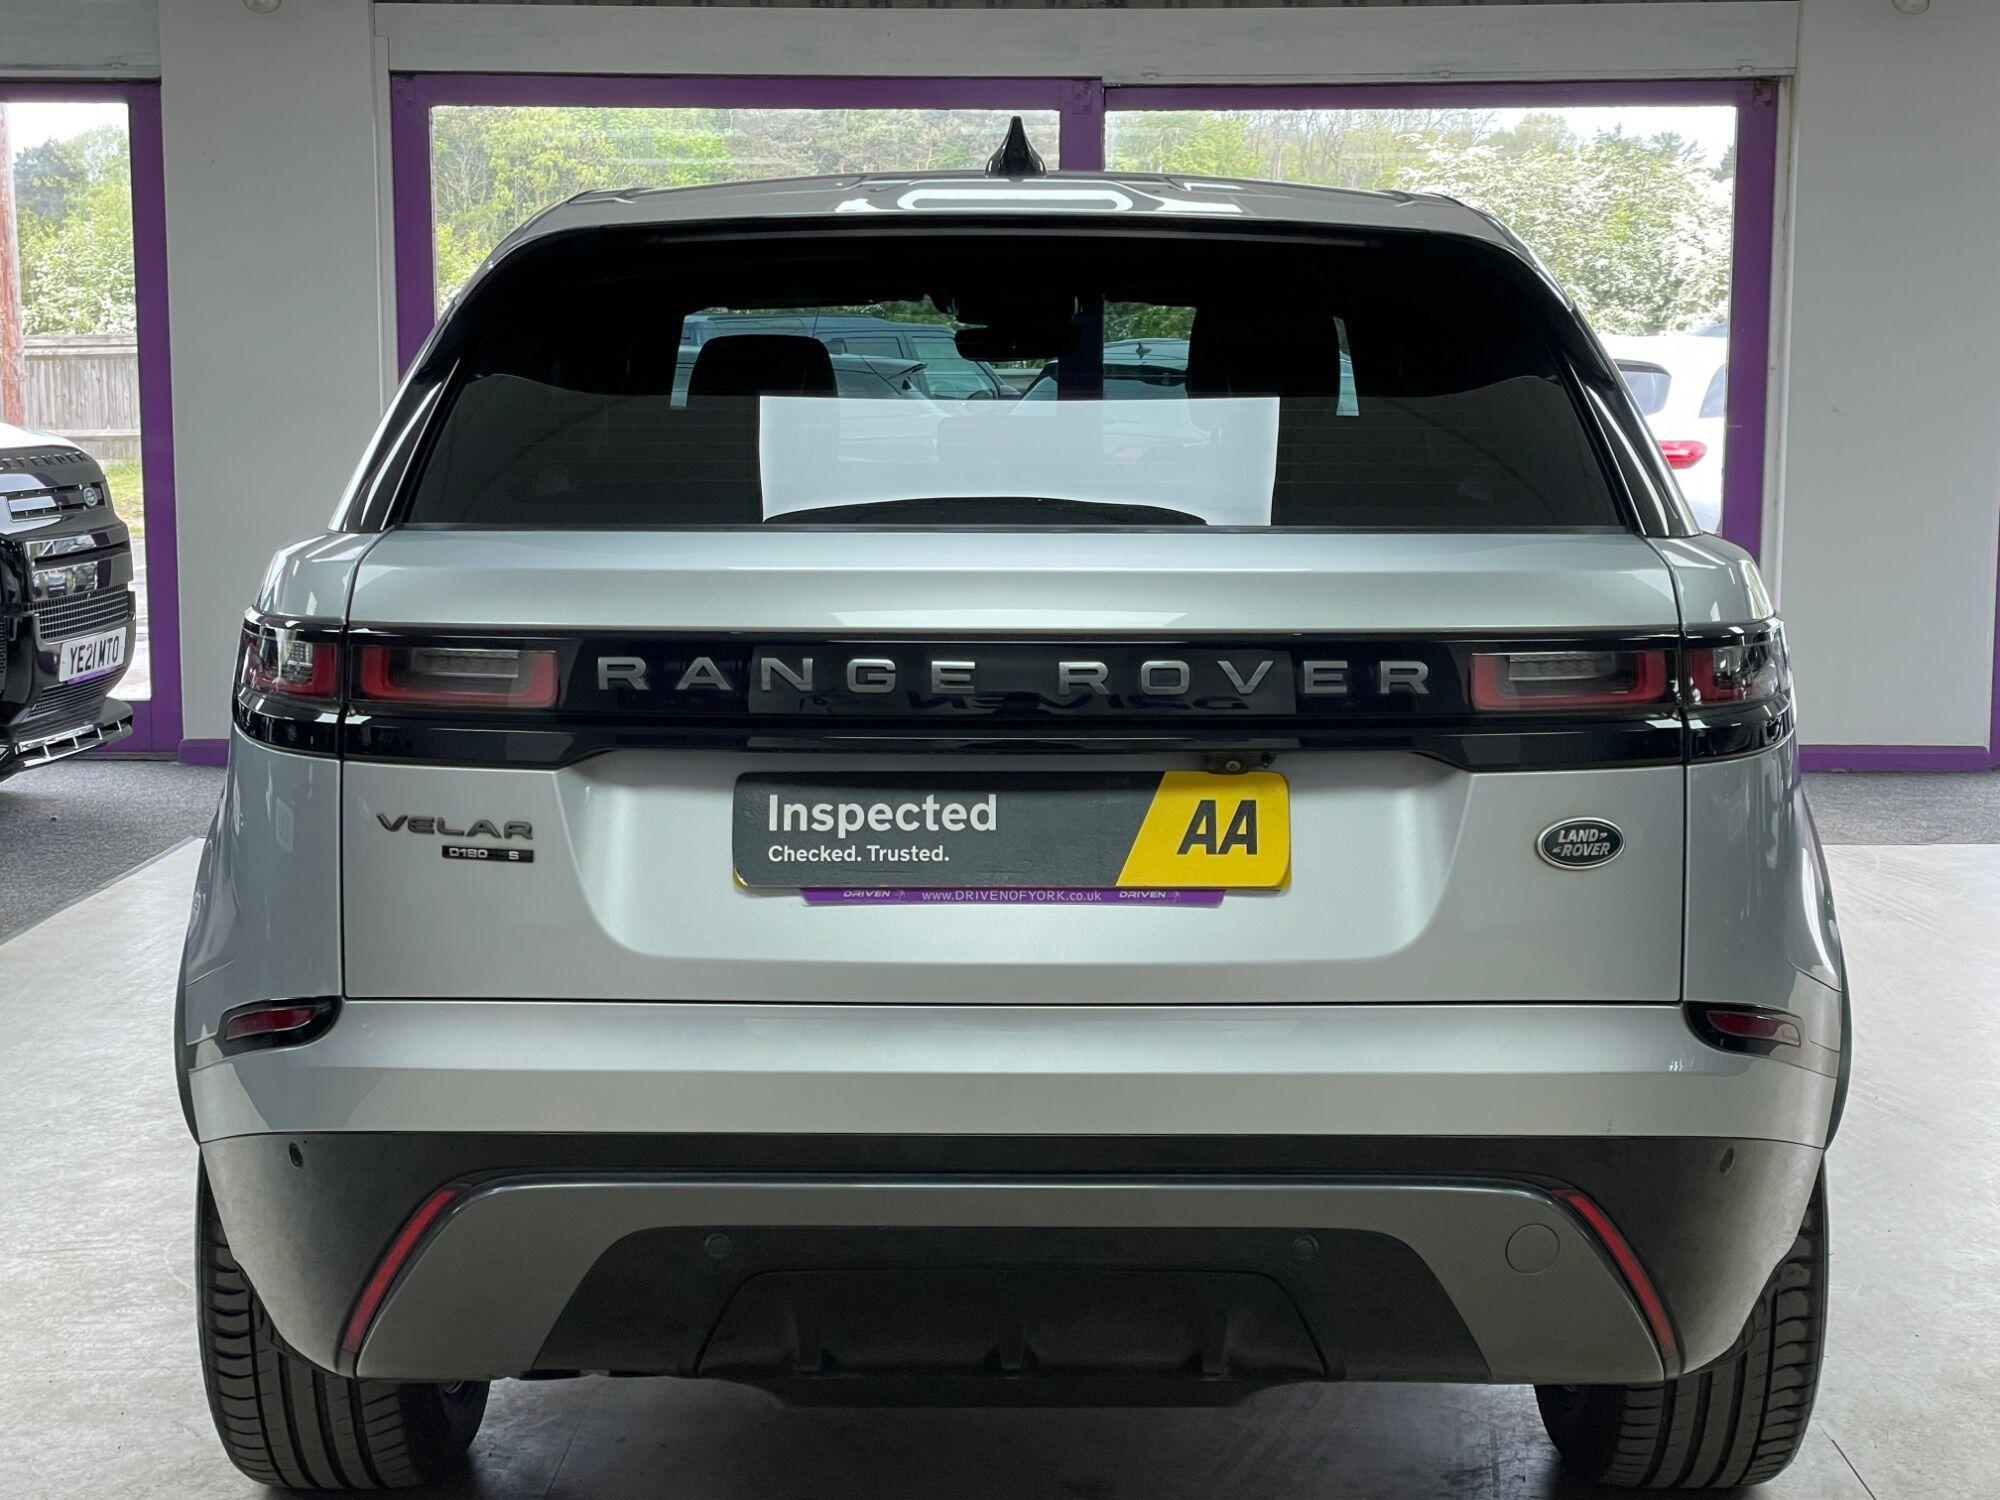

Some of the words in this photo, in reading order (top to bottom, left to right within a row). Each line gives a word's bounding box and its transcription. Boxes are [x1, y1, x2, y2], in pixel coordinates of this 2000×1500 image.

[70, 641, 97, 675] YE21
[98, 635, 120, 668] MTO
[597, 656, 976, 694] RANGE
[1057, 659, 1430, 695] ROVER
[376, 812, 534, 841] VELAR
[768, 794, 997, 839] Inspected
[1176, 800, 1258, 856] AA
[1558, 828, 1599, 843] LAND
[449, 847, 489, 859] D180
[508, 851, 520, 861] S
[768, 844, 862, 862] Checked.
[866, 844, 950, 862] Trusted.
[1560, 842, 1611, 857] ROVER
[843, 890, 891, 898] DRIVEN
[921, 890, 1102, 902] www.DRIVENOFYORK.co.uk
[1119, 891, 1167, 899] DRIVEN
